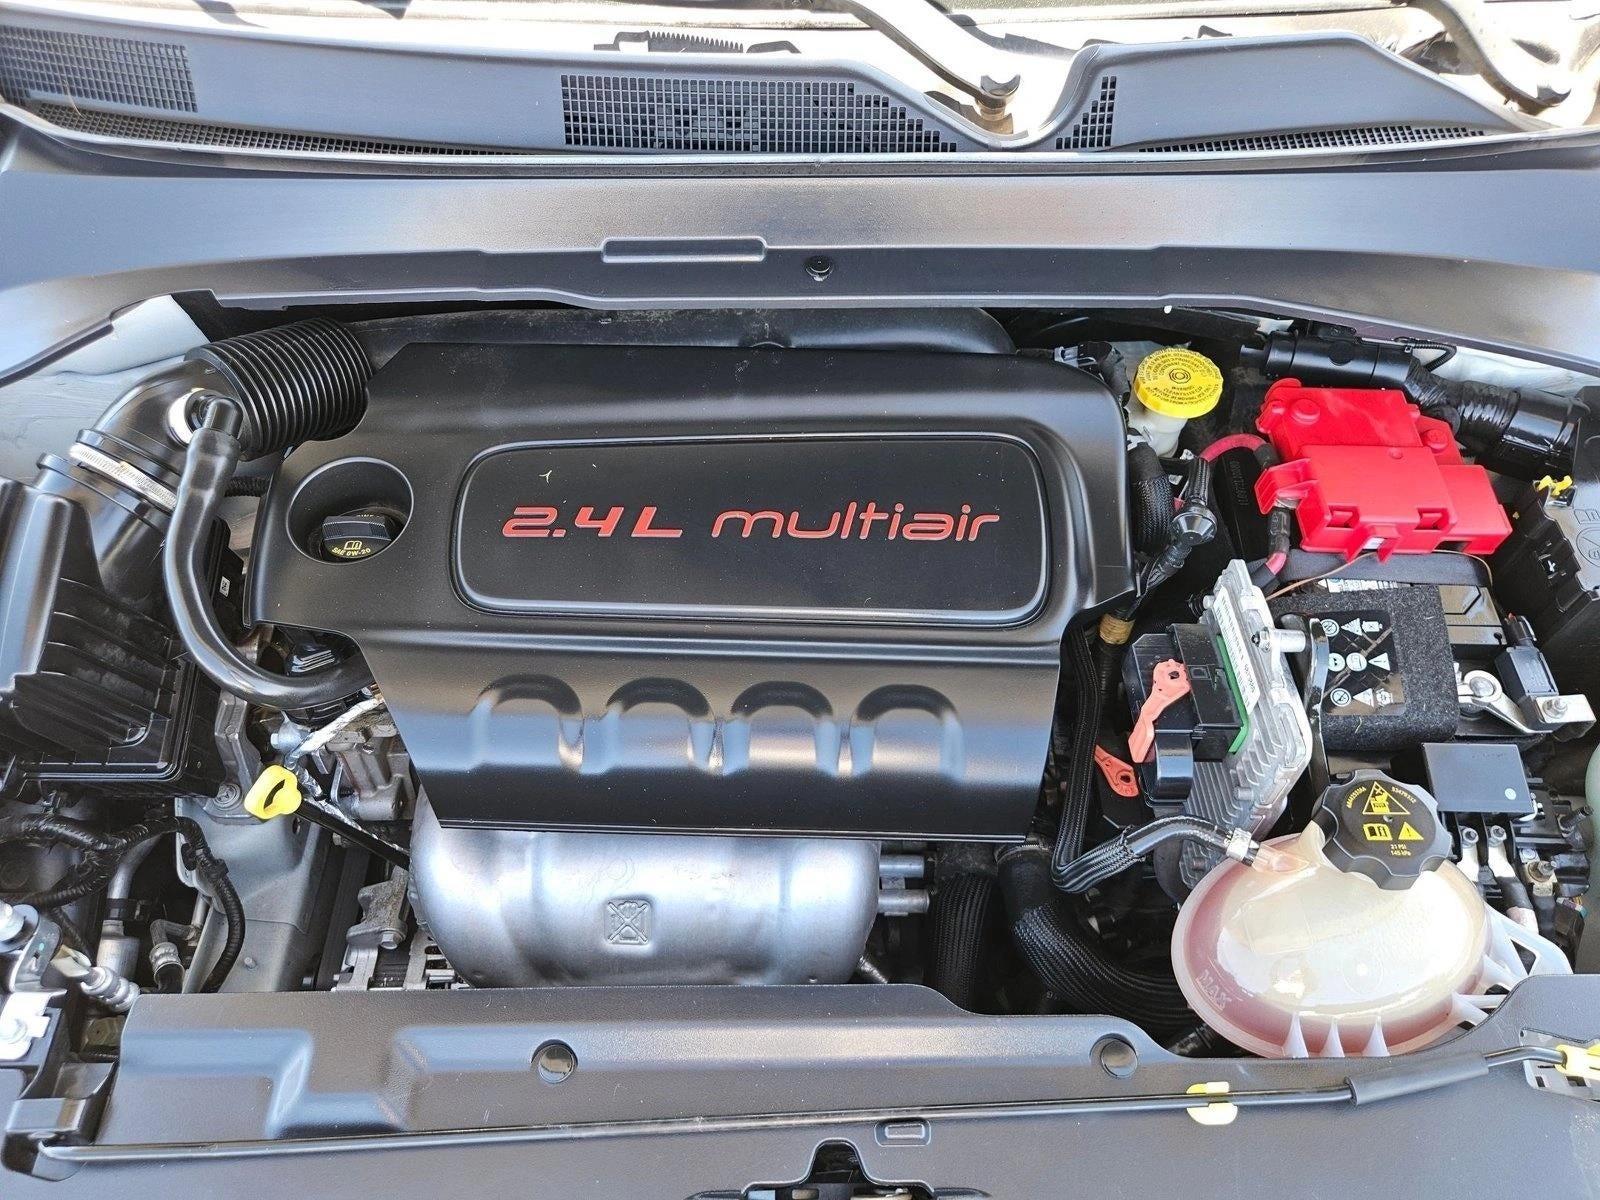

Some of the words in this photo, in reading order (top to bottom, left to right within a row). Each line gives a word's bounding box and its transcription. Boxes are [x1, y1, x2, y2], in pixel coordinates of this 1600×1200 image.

[711, 501, 1000, 541] multiair
[332, 547, 346, 556] SAE
[346, 548, 371, 556] 0W-20
